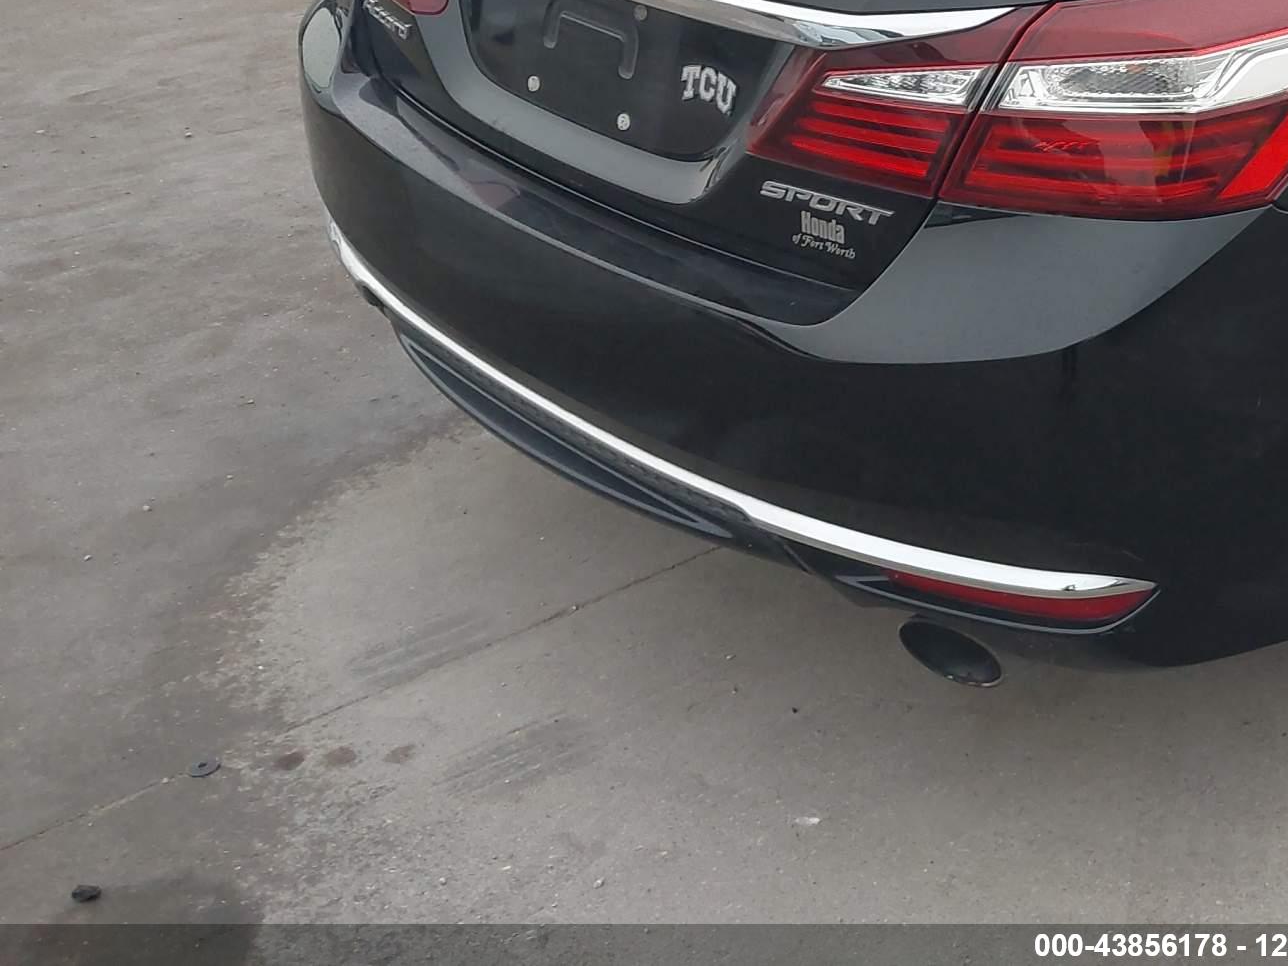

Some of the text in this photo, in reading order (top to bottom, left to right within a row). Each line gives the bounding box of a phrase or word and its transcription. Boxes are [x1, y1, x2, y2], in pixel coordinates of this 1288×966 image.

[680, 64, 737, 115] TCU
[760, 180, 895, 225] SPORT
[791, 233, 857, 260] of Fort Worth
[801, 210, 845, 244] Honda
